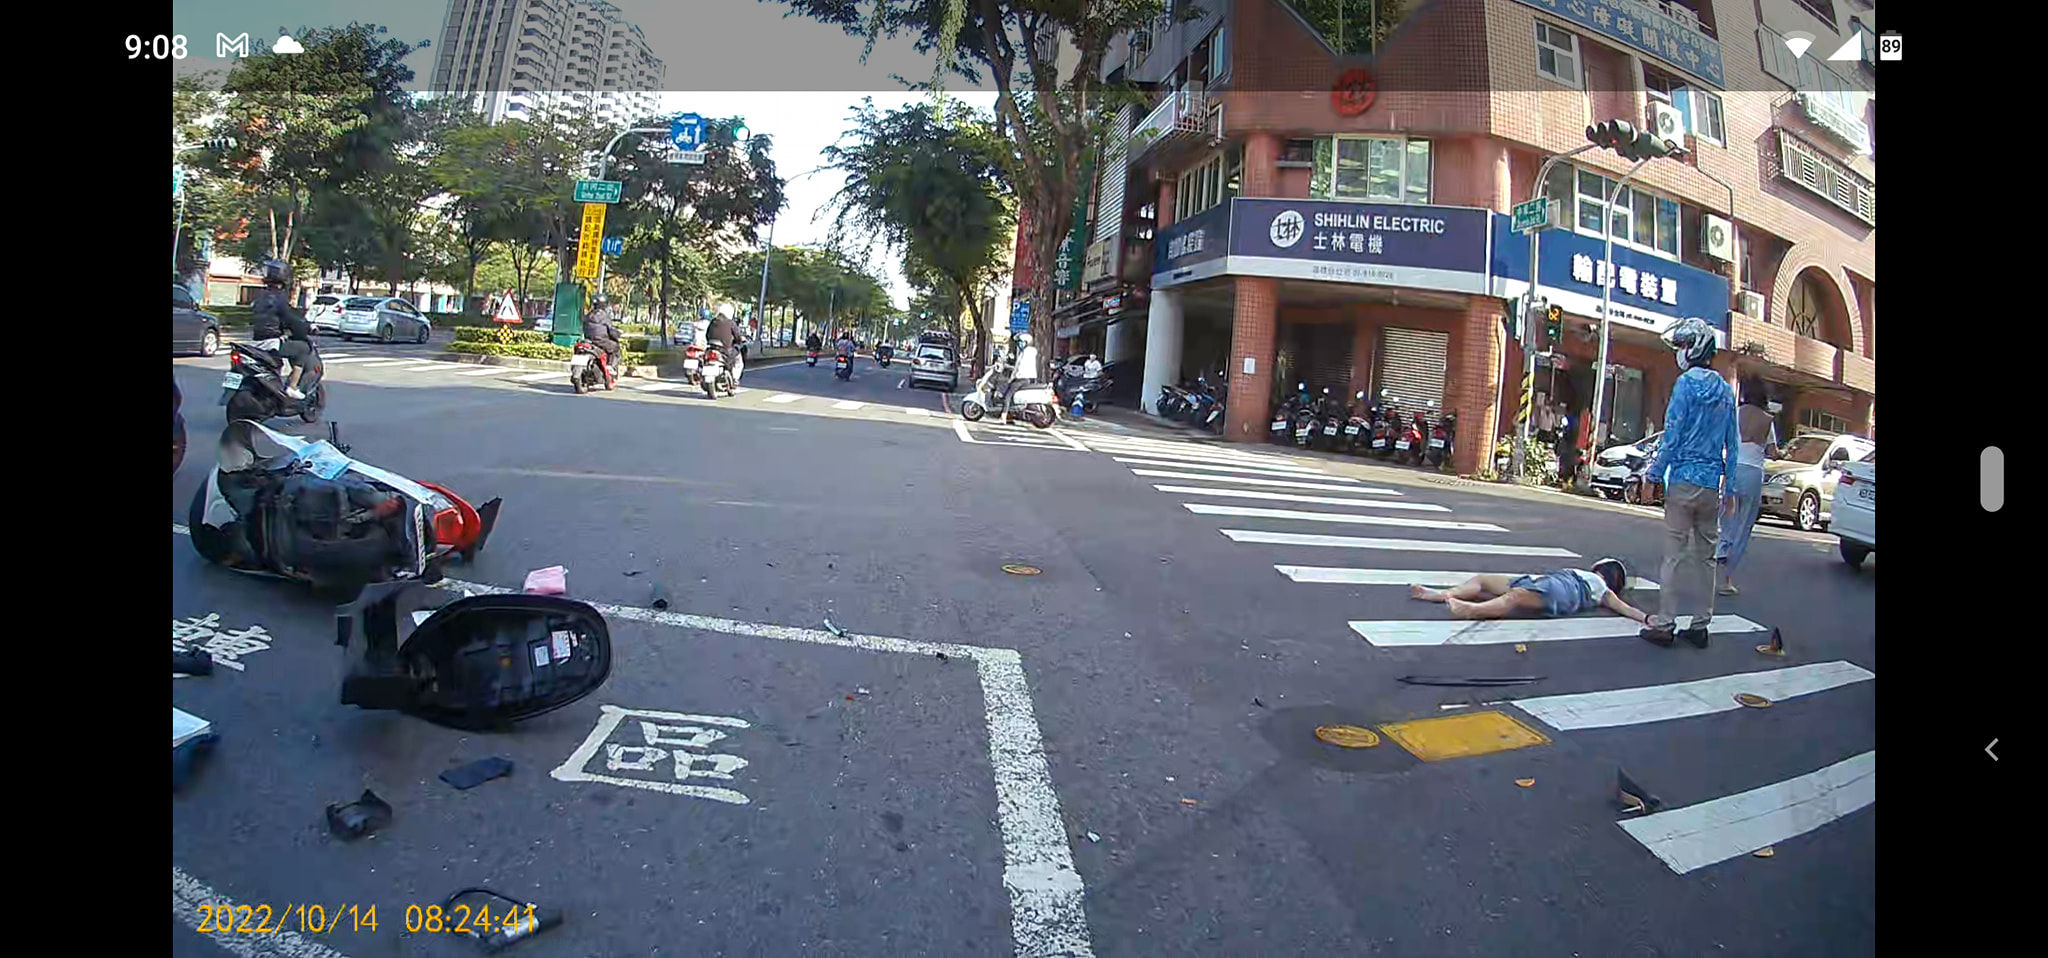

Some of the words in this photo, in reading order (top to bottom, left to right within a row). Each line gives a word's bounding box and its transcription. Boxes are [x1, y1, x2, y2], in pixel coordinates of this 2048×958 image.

[1315, 213, 1370, 229] SHIHLIN
[1374, 216, 1445, 233] ELECTRIC
[1313, 232, 1393, 254] 士林電機
[550, 705, 755, 804] 區
